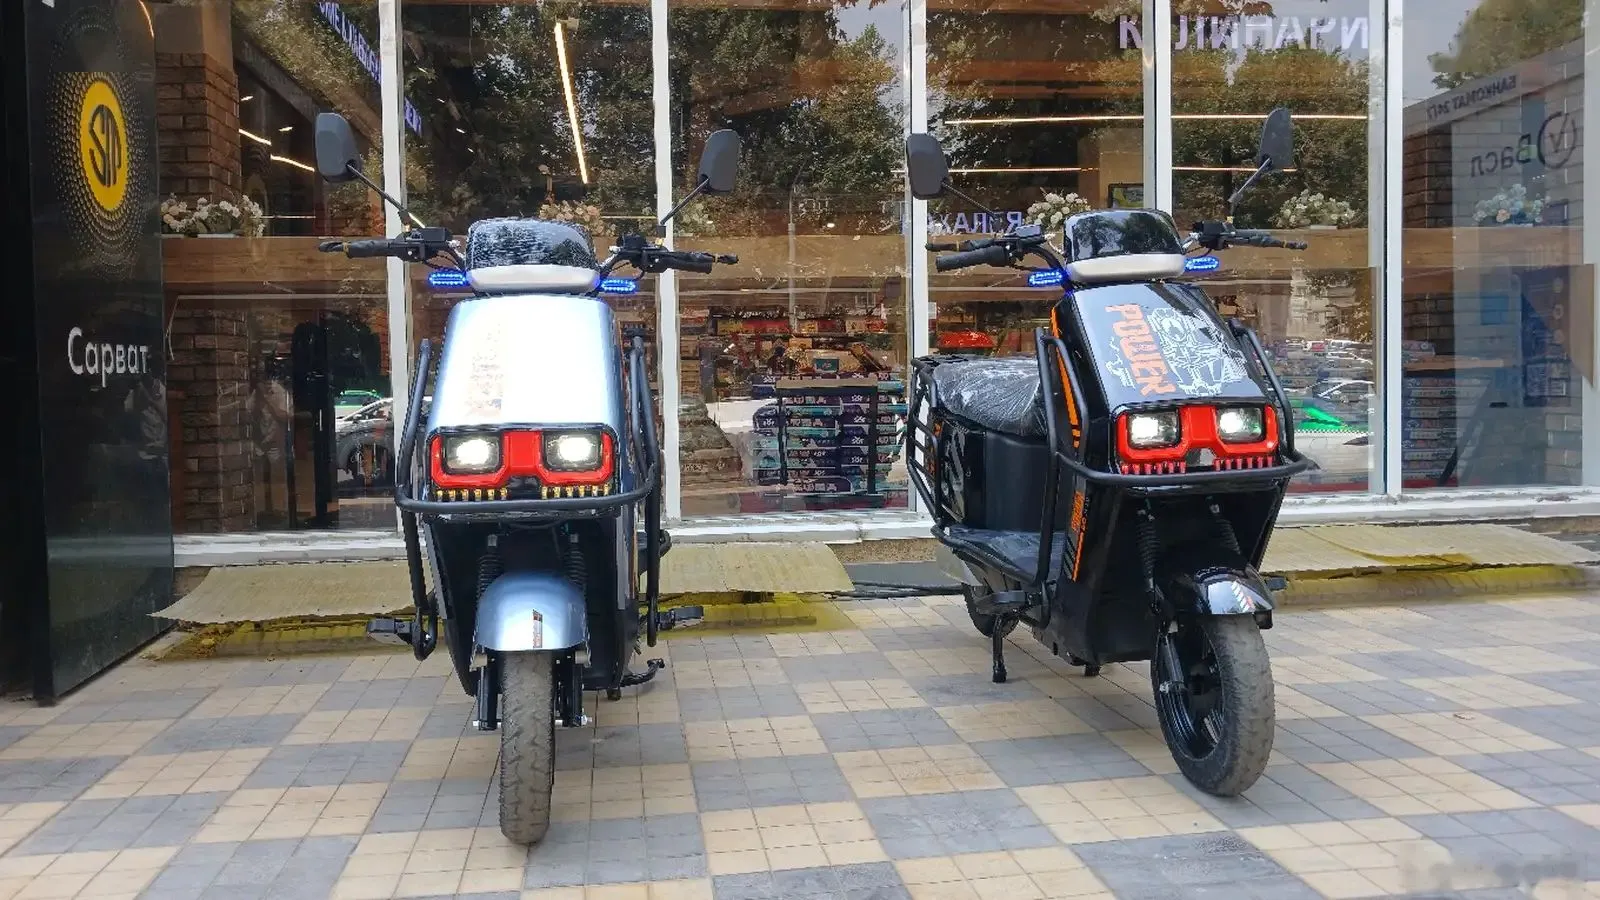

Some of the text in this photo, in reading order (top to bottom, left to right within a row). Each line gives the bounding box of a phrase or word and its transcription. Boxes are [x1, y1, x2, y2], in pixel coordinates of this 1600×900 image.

[1119, 15, 1369, 49] КЛИНАРИ
[68, 326, 149, 388] Сарват
[1104, 303, 1177, 397] POWER
